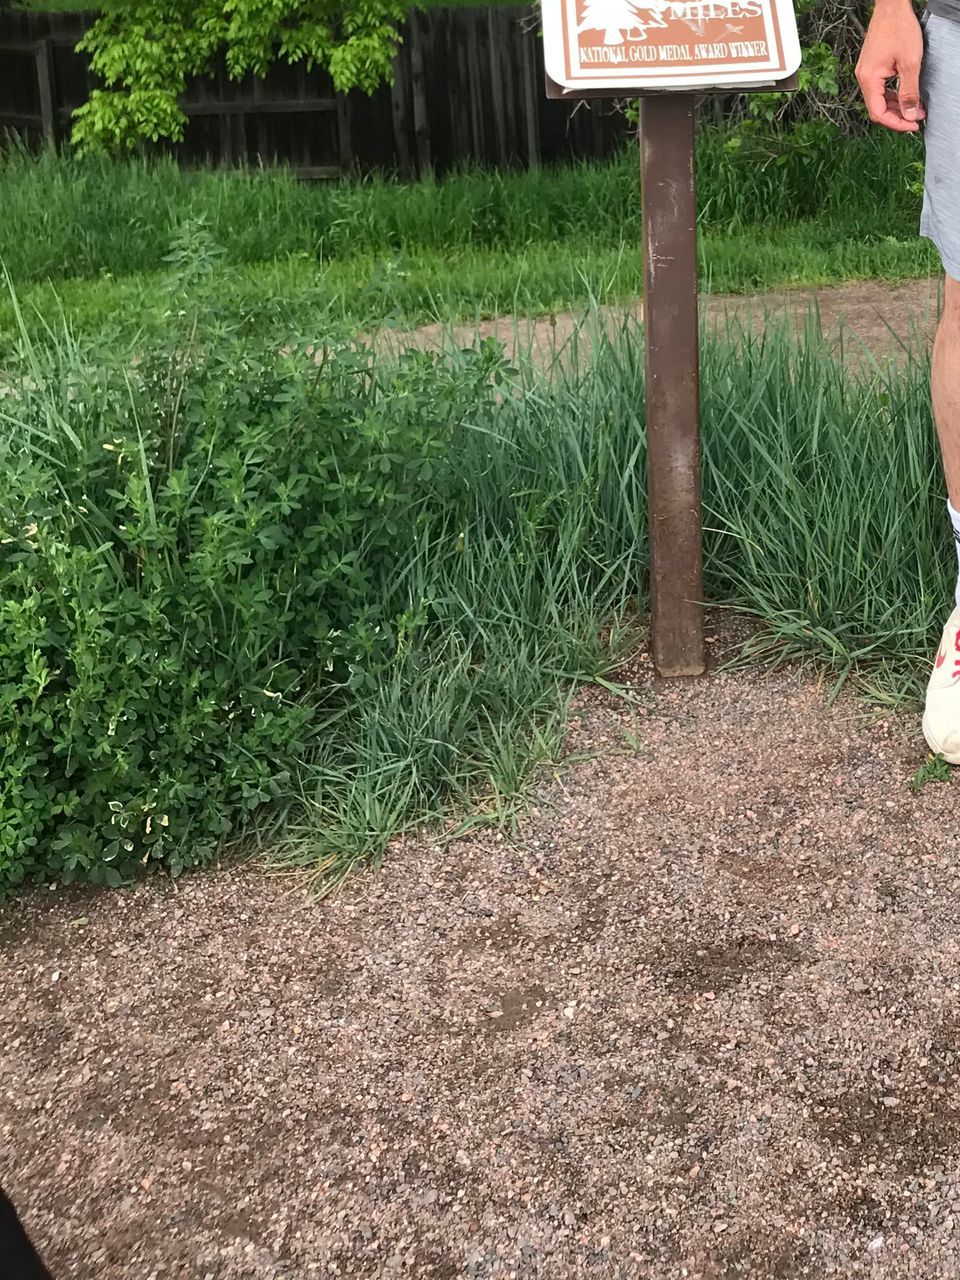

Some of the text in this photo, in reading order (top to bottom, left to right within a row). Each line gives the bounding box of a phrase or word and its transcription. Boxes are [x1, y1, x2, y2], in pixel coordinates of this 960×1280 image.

[579, 40, 769, 64] NATIONAL GOLD MEDAL AWARD WINNER
